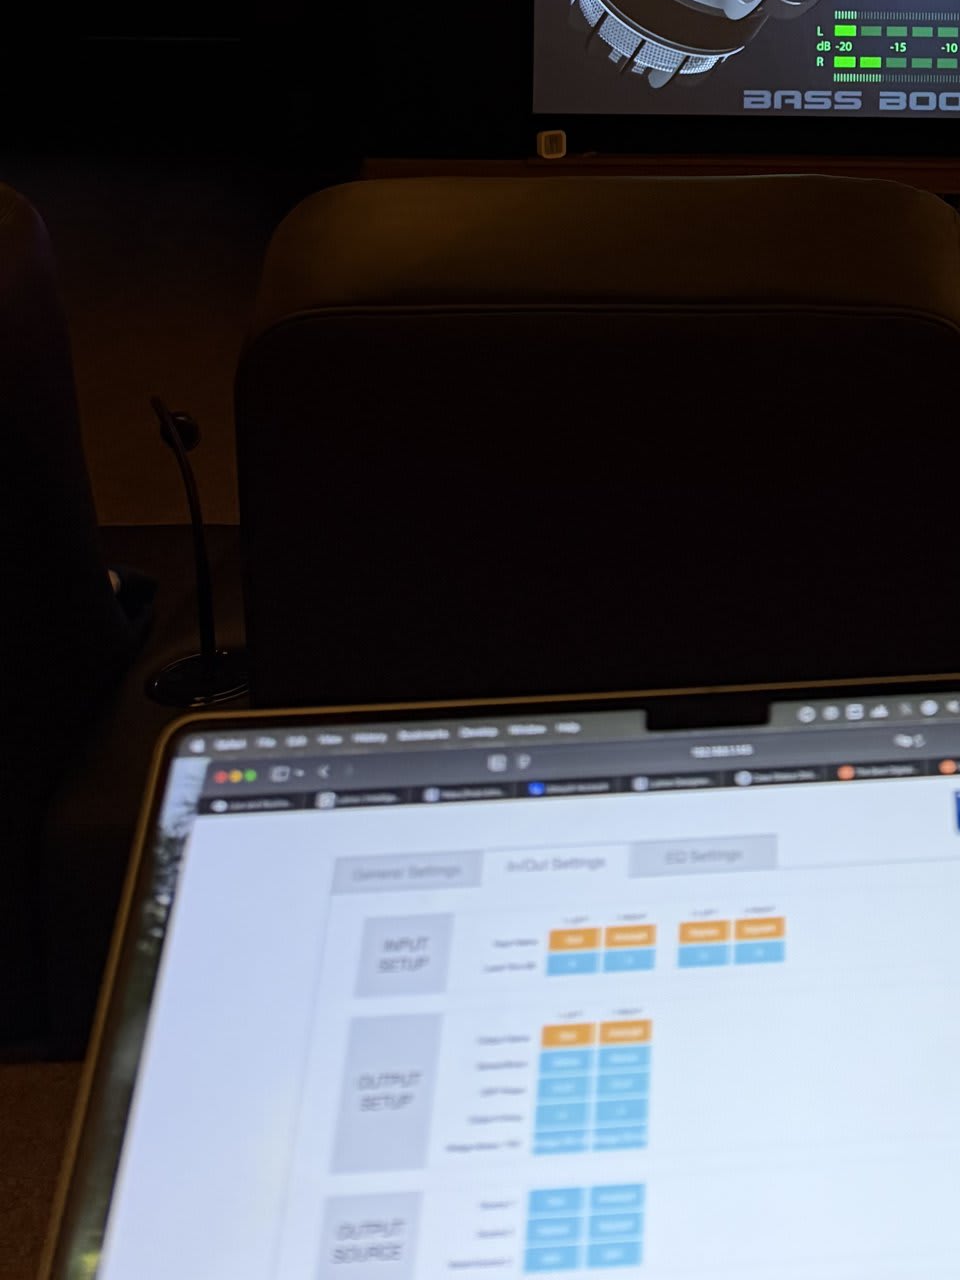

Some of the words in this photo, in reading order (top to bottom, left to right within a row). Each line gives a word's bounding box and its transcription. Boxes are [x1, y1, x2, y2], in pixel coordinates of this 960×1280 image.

[816, 25, 824, 37] L
[816, 40, 832, 52] dB
[834, 41, 853, 52] -20
[889, 42, 907, 53] -15
[940, 42, 959, 54] -10
[816, 56, 824, 67] R
[742, 89, 863, 111] BASS
[383, 936, 430, 954] INPUT
[377, 954, 430, 973] SETUP
[357, 1070, 423, 1090] OUTPUT
[359, 1092, 415, 1112] SETUP
[331, 1244, 404, 1265] SOURCE
